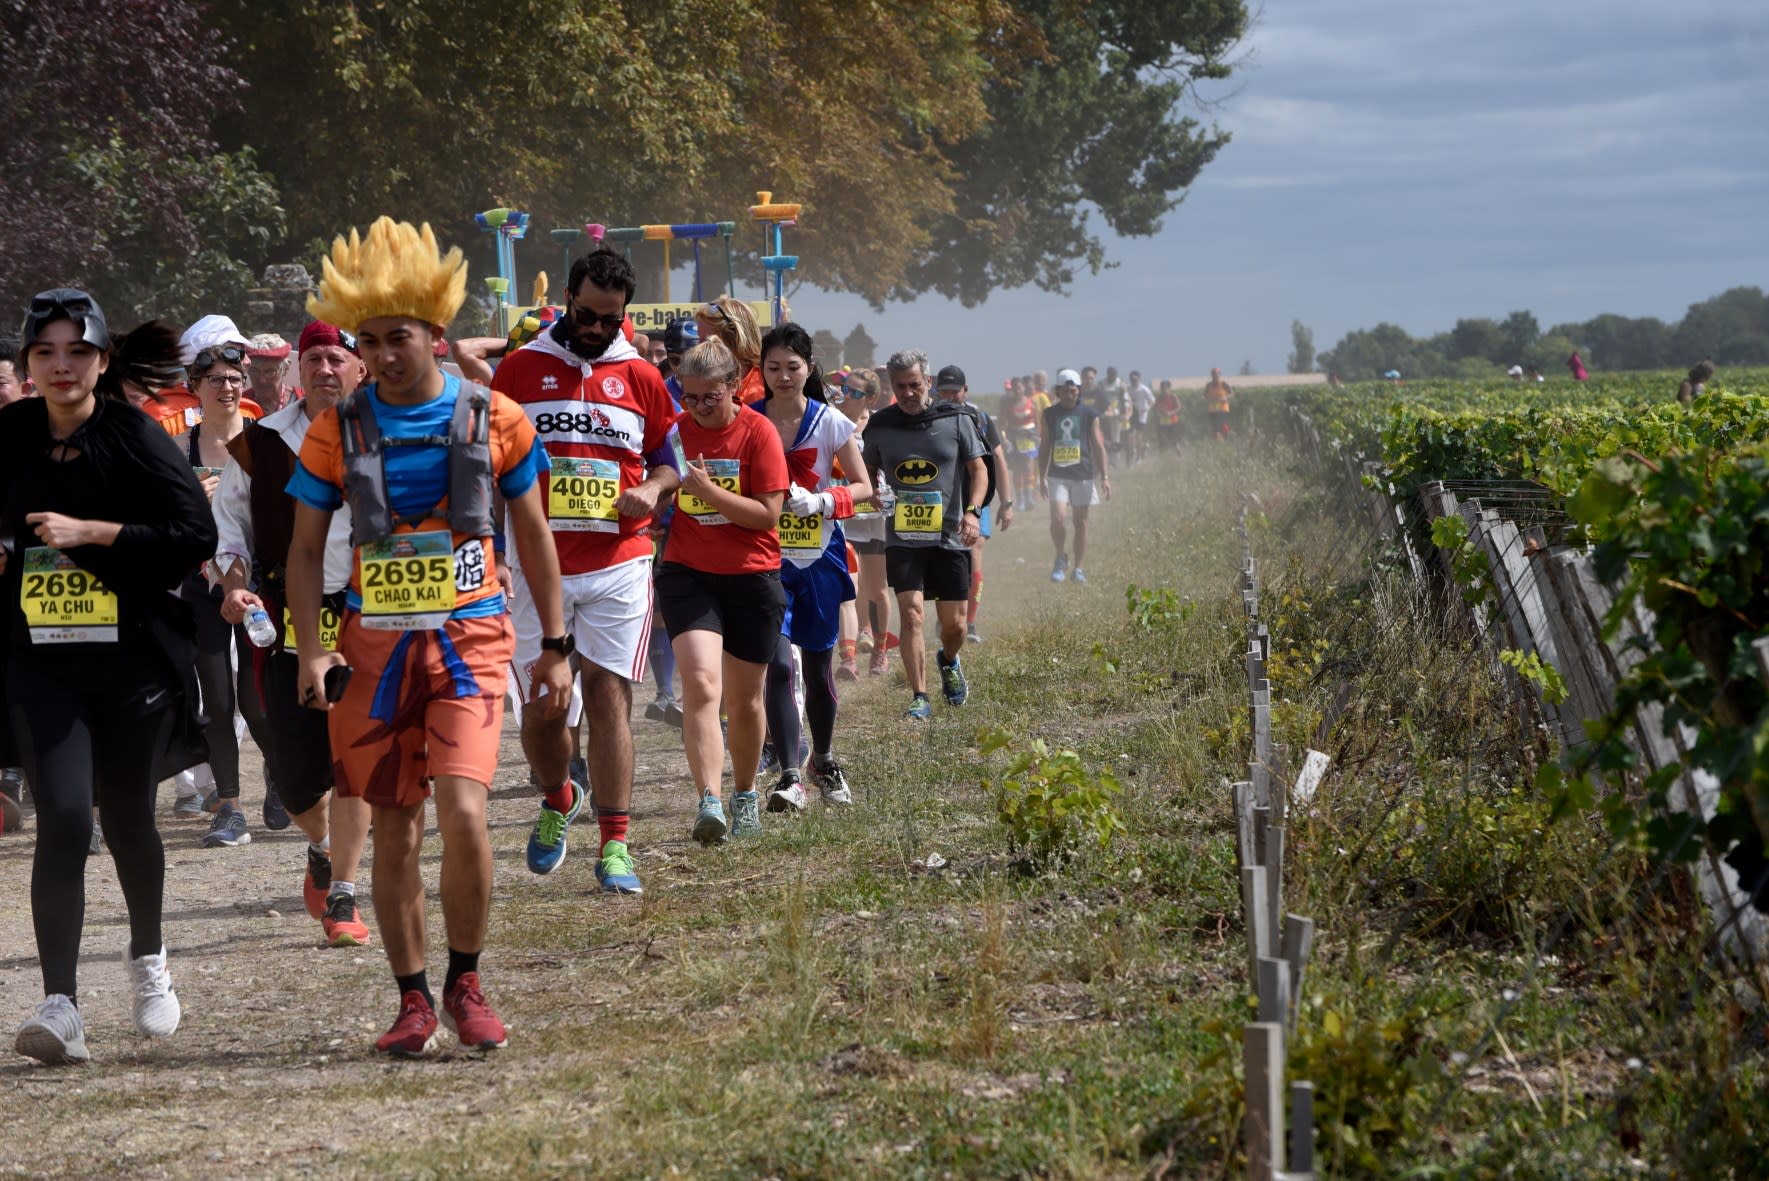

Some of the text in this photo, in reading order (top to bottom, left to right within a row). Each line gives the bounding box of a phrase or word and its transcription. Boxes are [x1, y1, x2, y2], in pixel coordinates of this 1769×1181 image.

[535, 411, 630, 441] 888.com
[552, 477, 616, 499] 4005
[568, 498, 601, 510] DIEGO
[903, 505, 935, 518] 307
[779, 513, 819, 529] 636
[906, 519, 932, 527] BRUNO
[779, 531, 811, 541] HIYUKI
[364, 558, 449, 588] 2695
[25, 571, 109, 599] 2694
[374, 586, 441, 604] CHAO KAI
[39, 599, 94, 614] YA CHU
